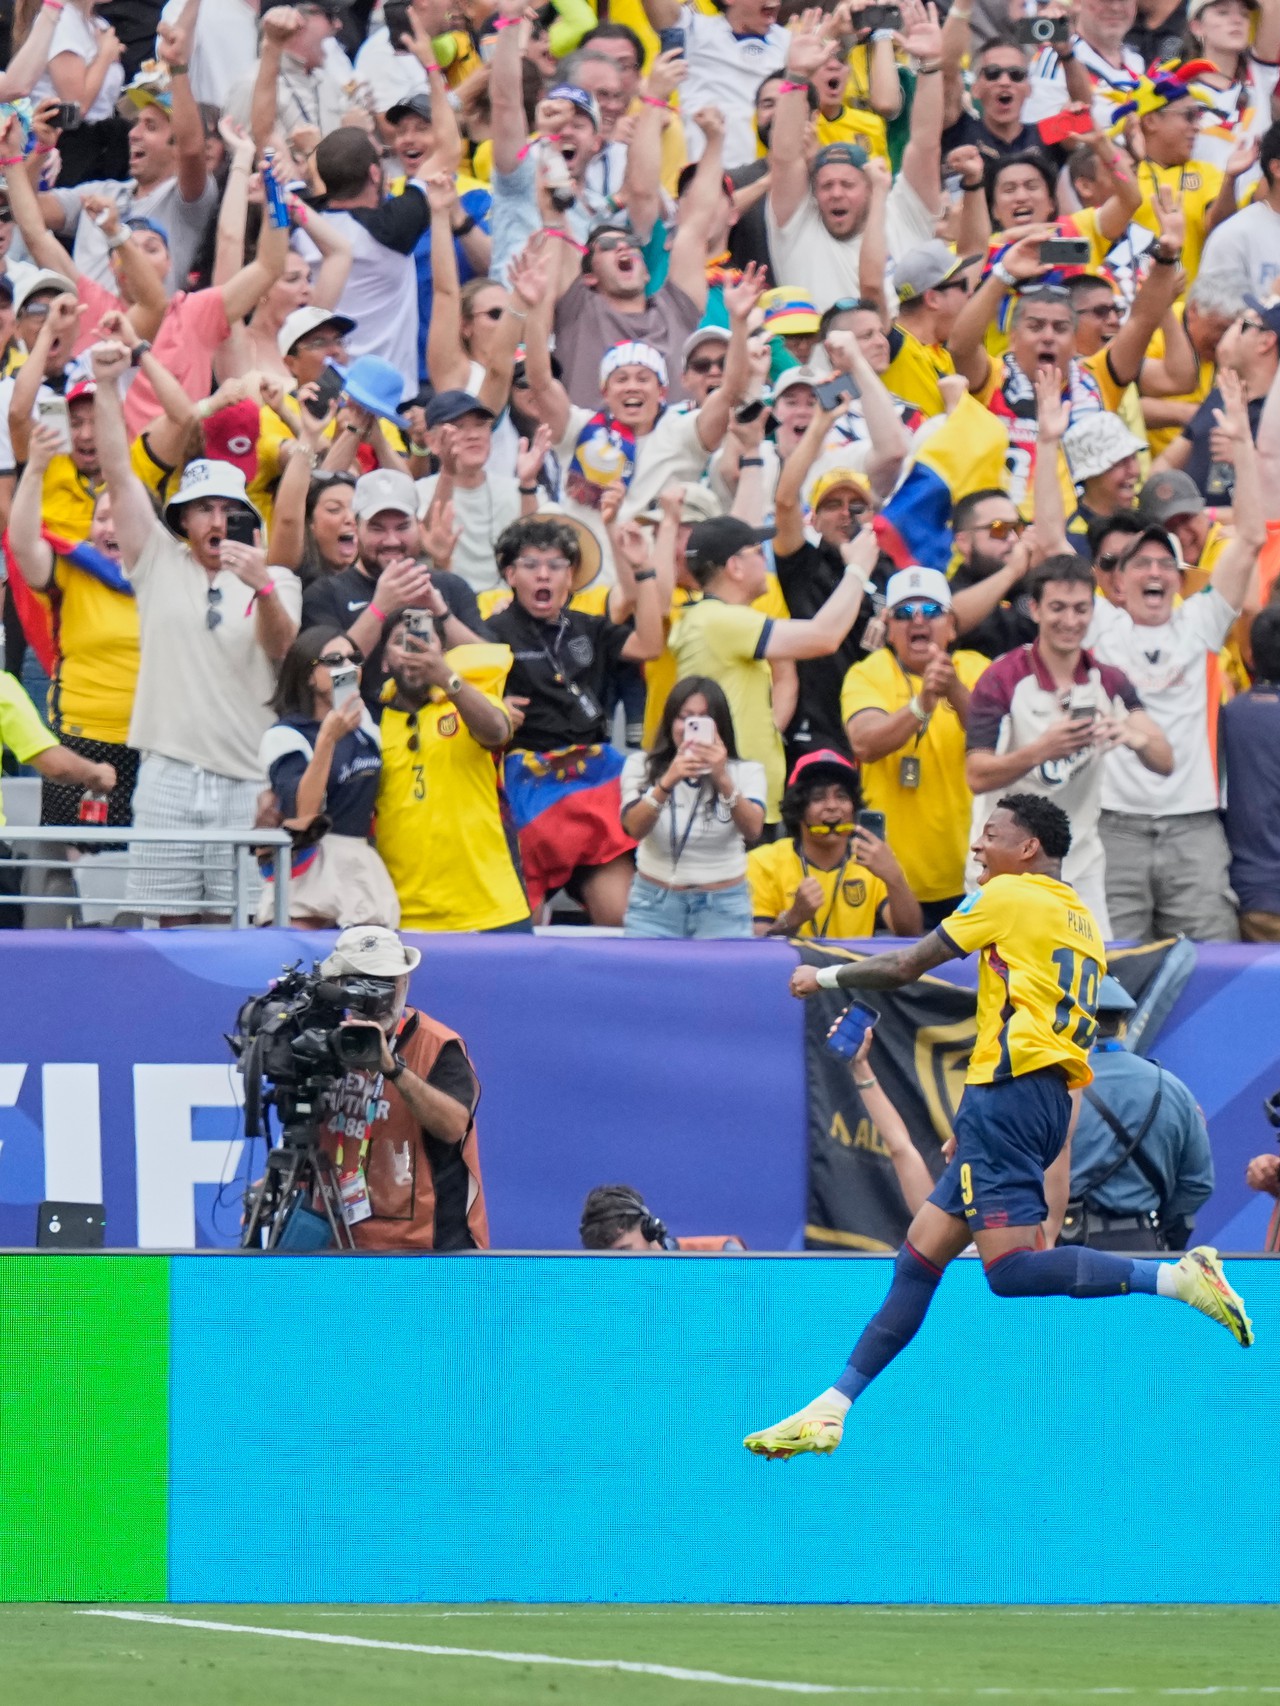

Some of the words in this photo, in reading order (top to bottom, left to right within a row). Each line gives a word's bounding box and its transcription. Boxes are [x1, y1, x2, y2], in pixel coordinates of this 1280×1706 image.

[412, 766, 425, 799] 3
[1067, 910, 1094, 942] PLATA
[1051, 947, 1101, 1050] 19
